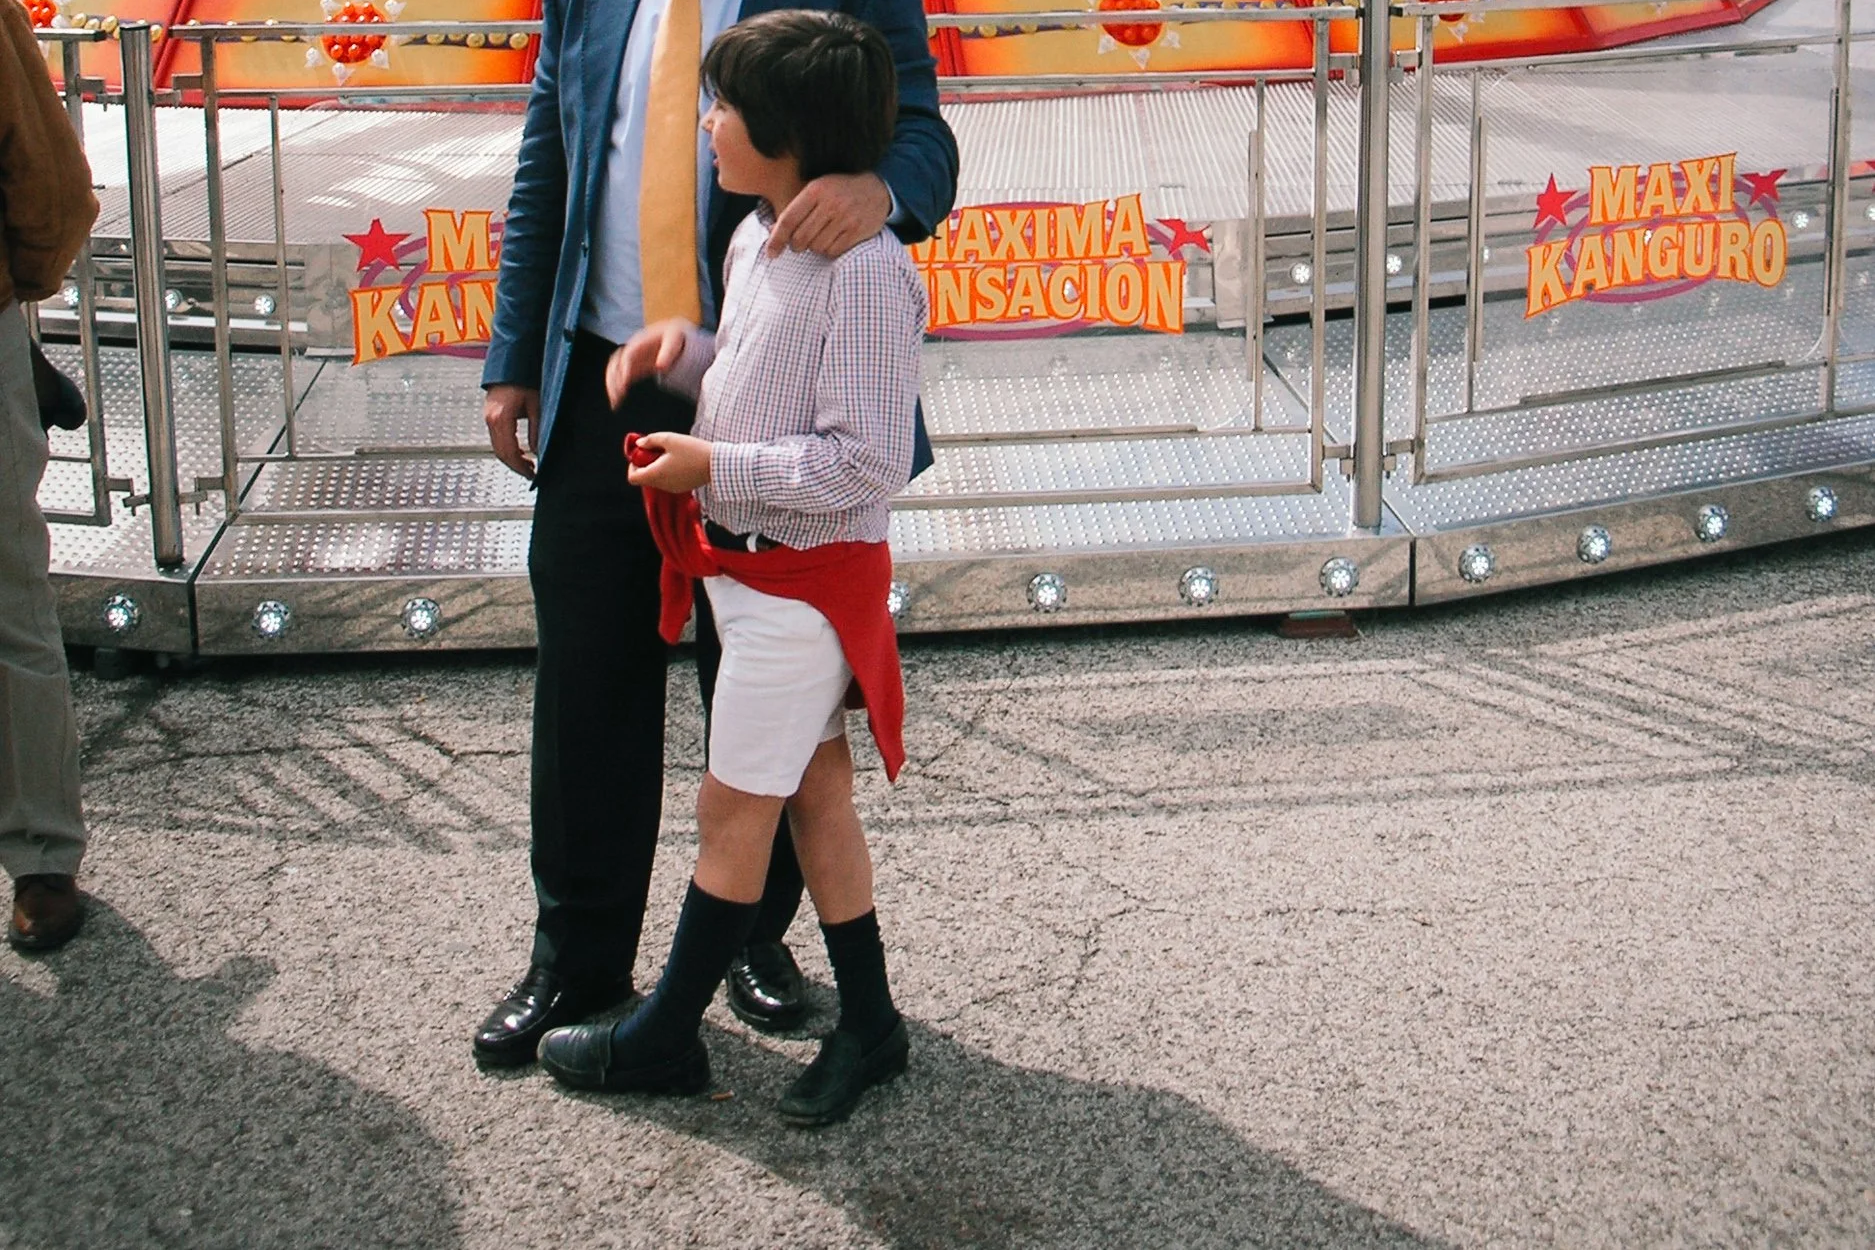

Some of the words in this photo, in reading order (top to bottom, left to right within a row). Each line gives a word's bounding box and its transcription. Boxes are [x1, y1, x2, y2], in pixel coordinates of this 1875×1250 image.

[1589, 153, 1736, 224] MAXI
[918, 260, 1187, 335] NSACION
[1525, 219, 1787, 318] KANGURO
